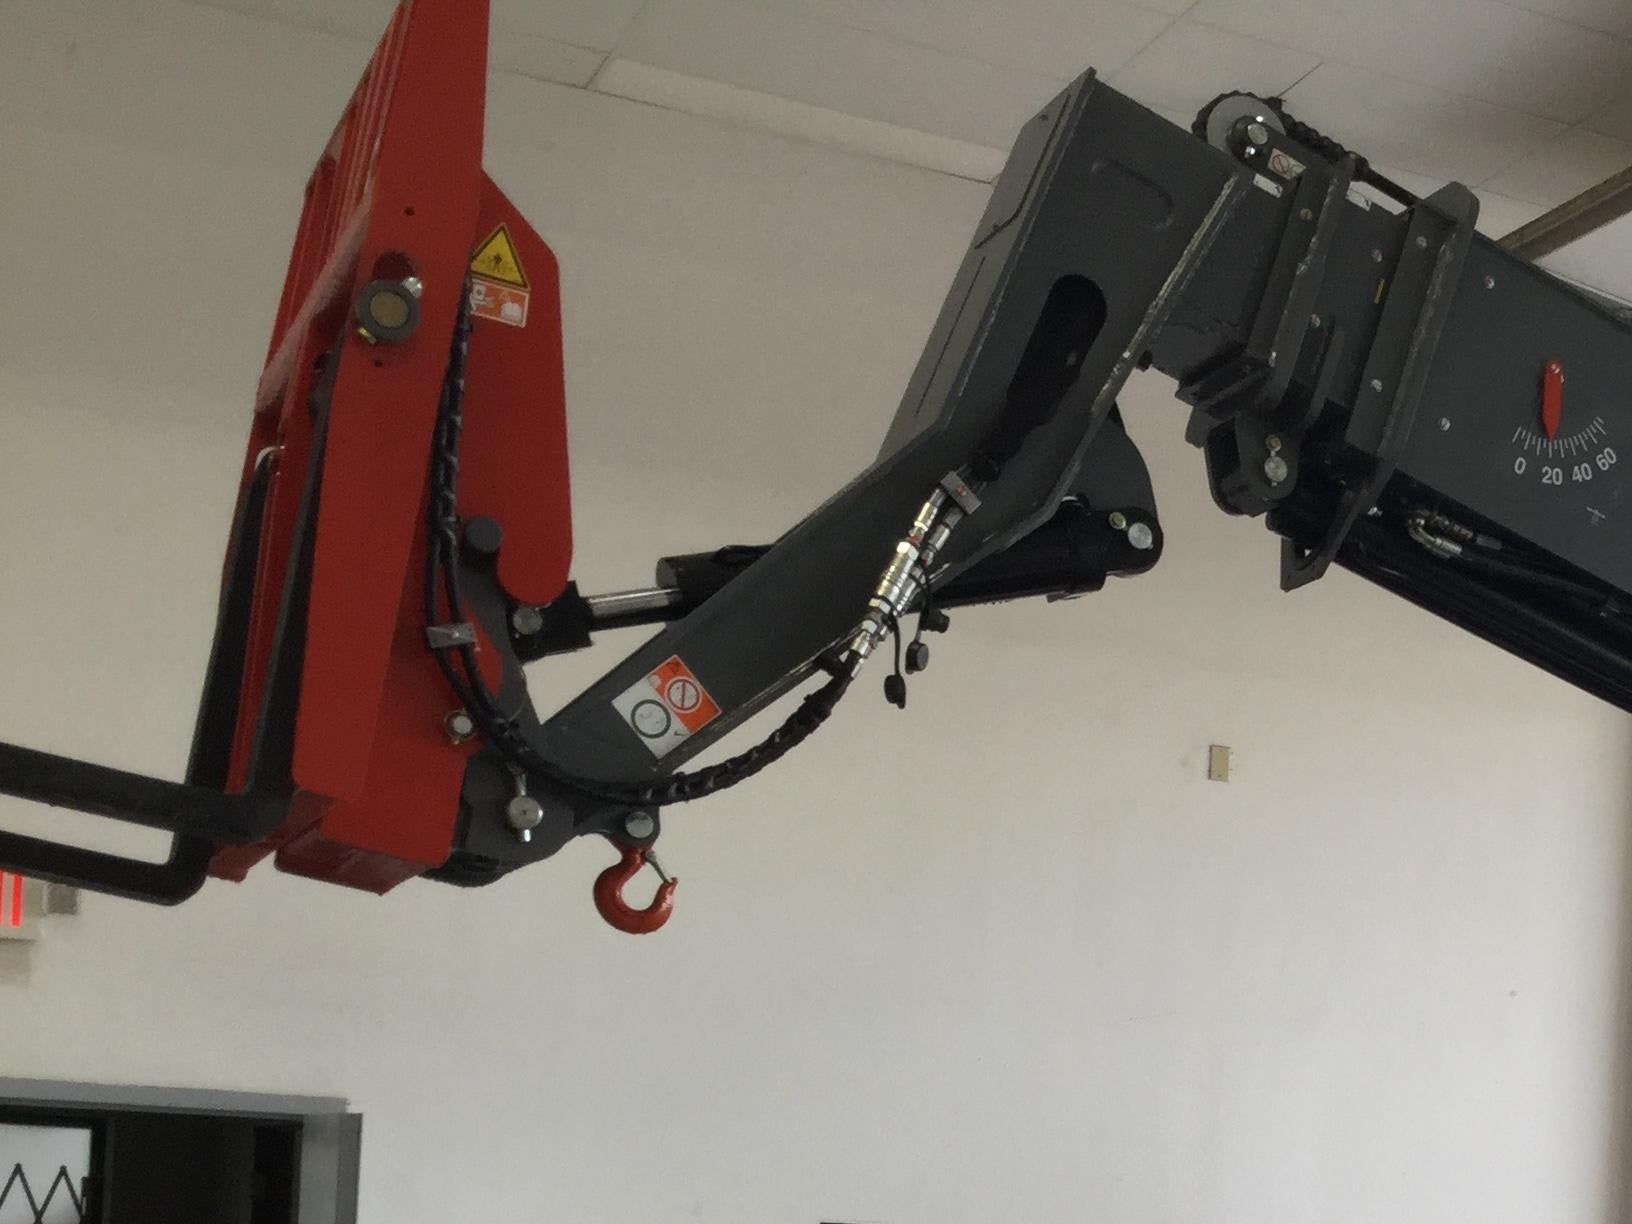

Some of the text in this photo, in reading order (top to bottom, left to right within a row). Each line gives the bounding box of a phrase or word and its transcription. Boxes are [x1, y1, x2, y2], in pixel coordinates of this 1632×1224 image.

[1514, 447, 1617, 486] 0 20 40 60
